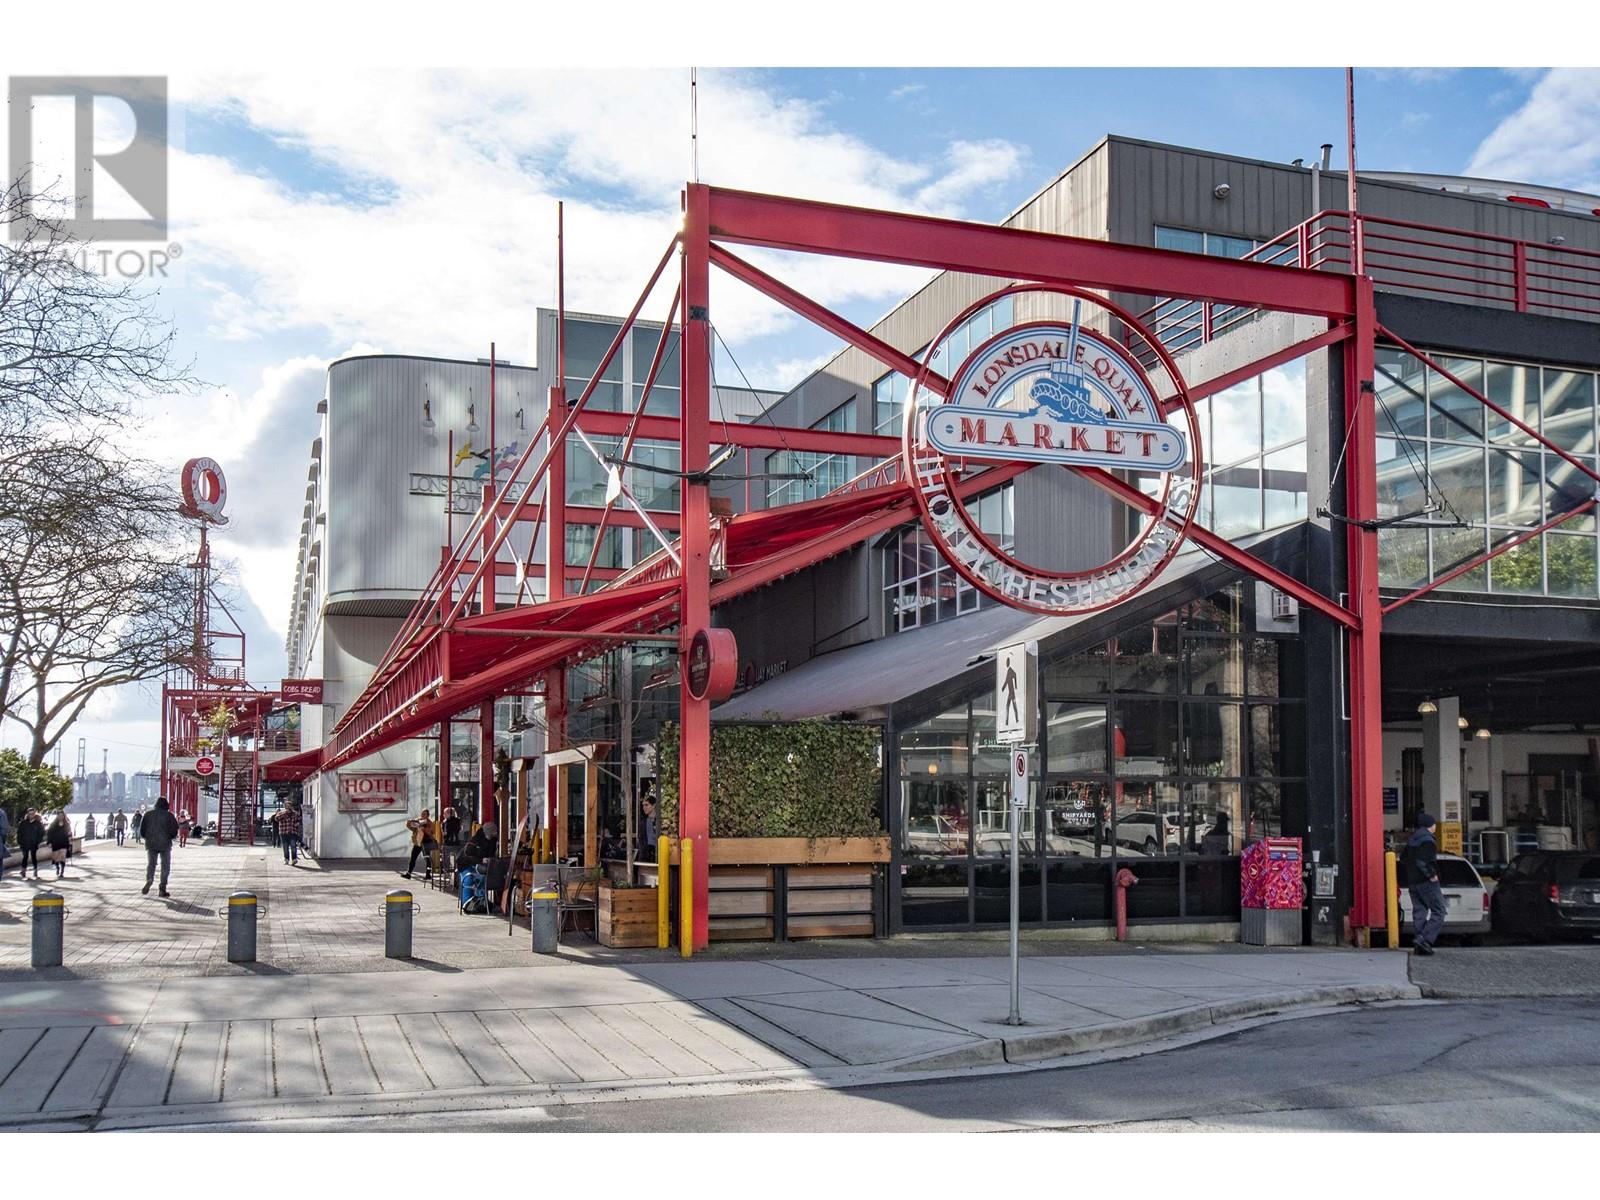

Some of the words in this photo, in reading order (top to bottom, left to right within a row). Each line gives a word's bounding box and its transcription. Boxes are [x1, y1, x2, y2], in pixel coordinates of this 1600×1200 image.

[972, 340, 1086, 399] LONSDALE
[1094, 357, 1146, 415] QUAY
[960, 416, 1159, 457] MARKET
[1006, 488, 1191, 607] RESTAURANTS
[300, 685, 321, 694] BREAD
[345, 779, 401, 793] HOTEL
